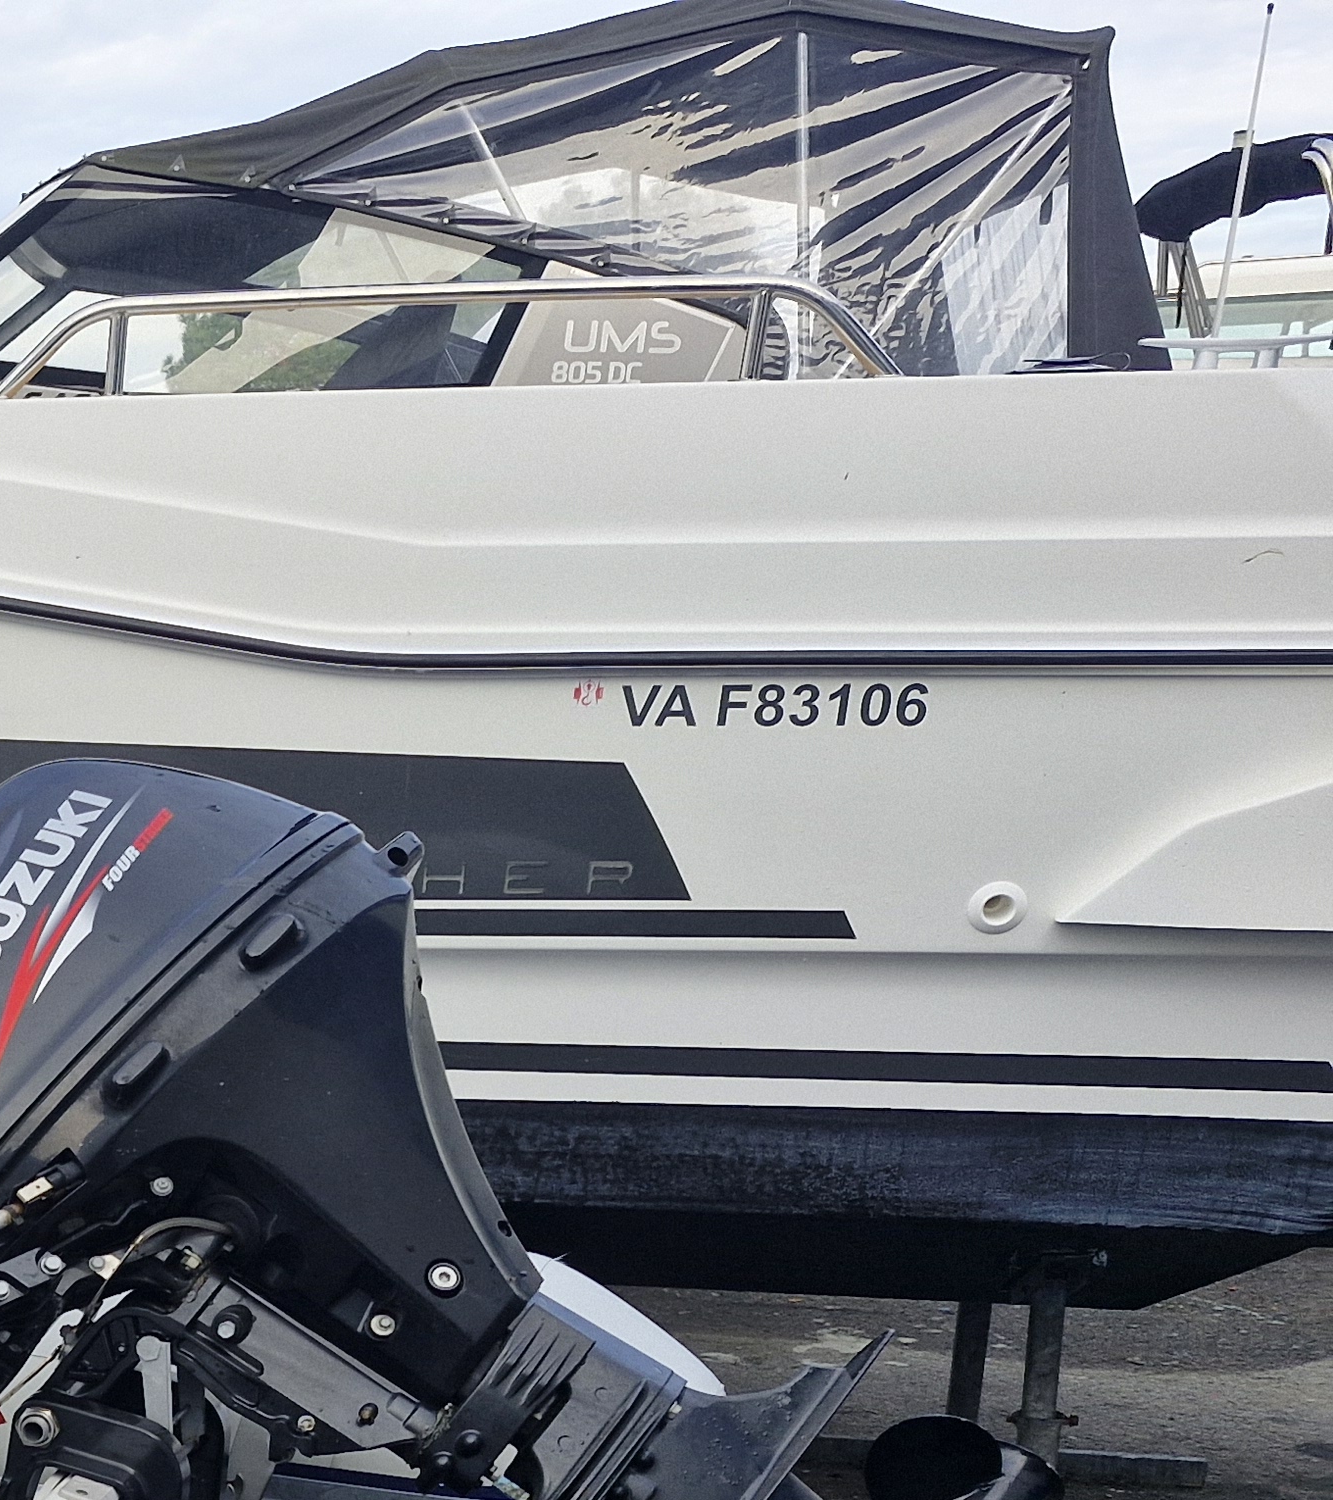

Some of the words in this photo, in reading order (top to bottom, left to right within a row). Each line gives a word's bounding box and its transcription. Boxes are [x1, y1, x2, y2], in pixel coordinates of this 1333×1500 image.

[563, 319, 682, 354] UMS
[550, 361, 603, 384] 805
[606, 361, 643, 384] DC
[622, 684, 697, 727] VA
[716, 683, 930, 727] F83106
